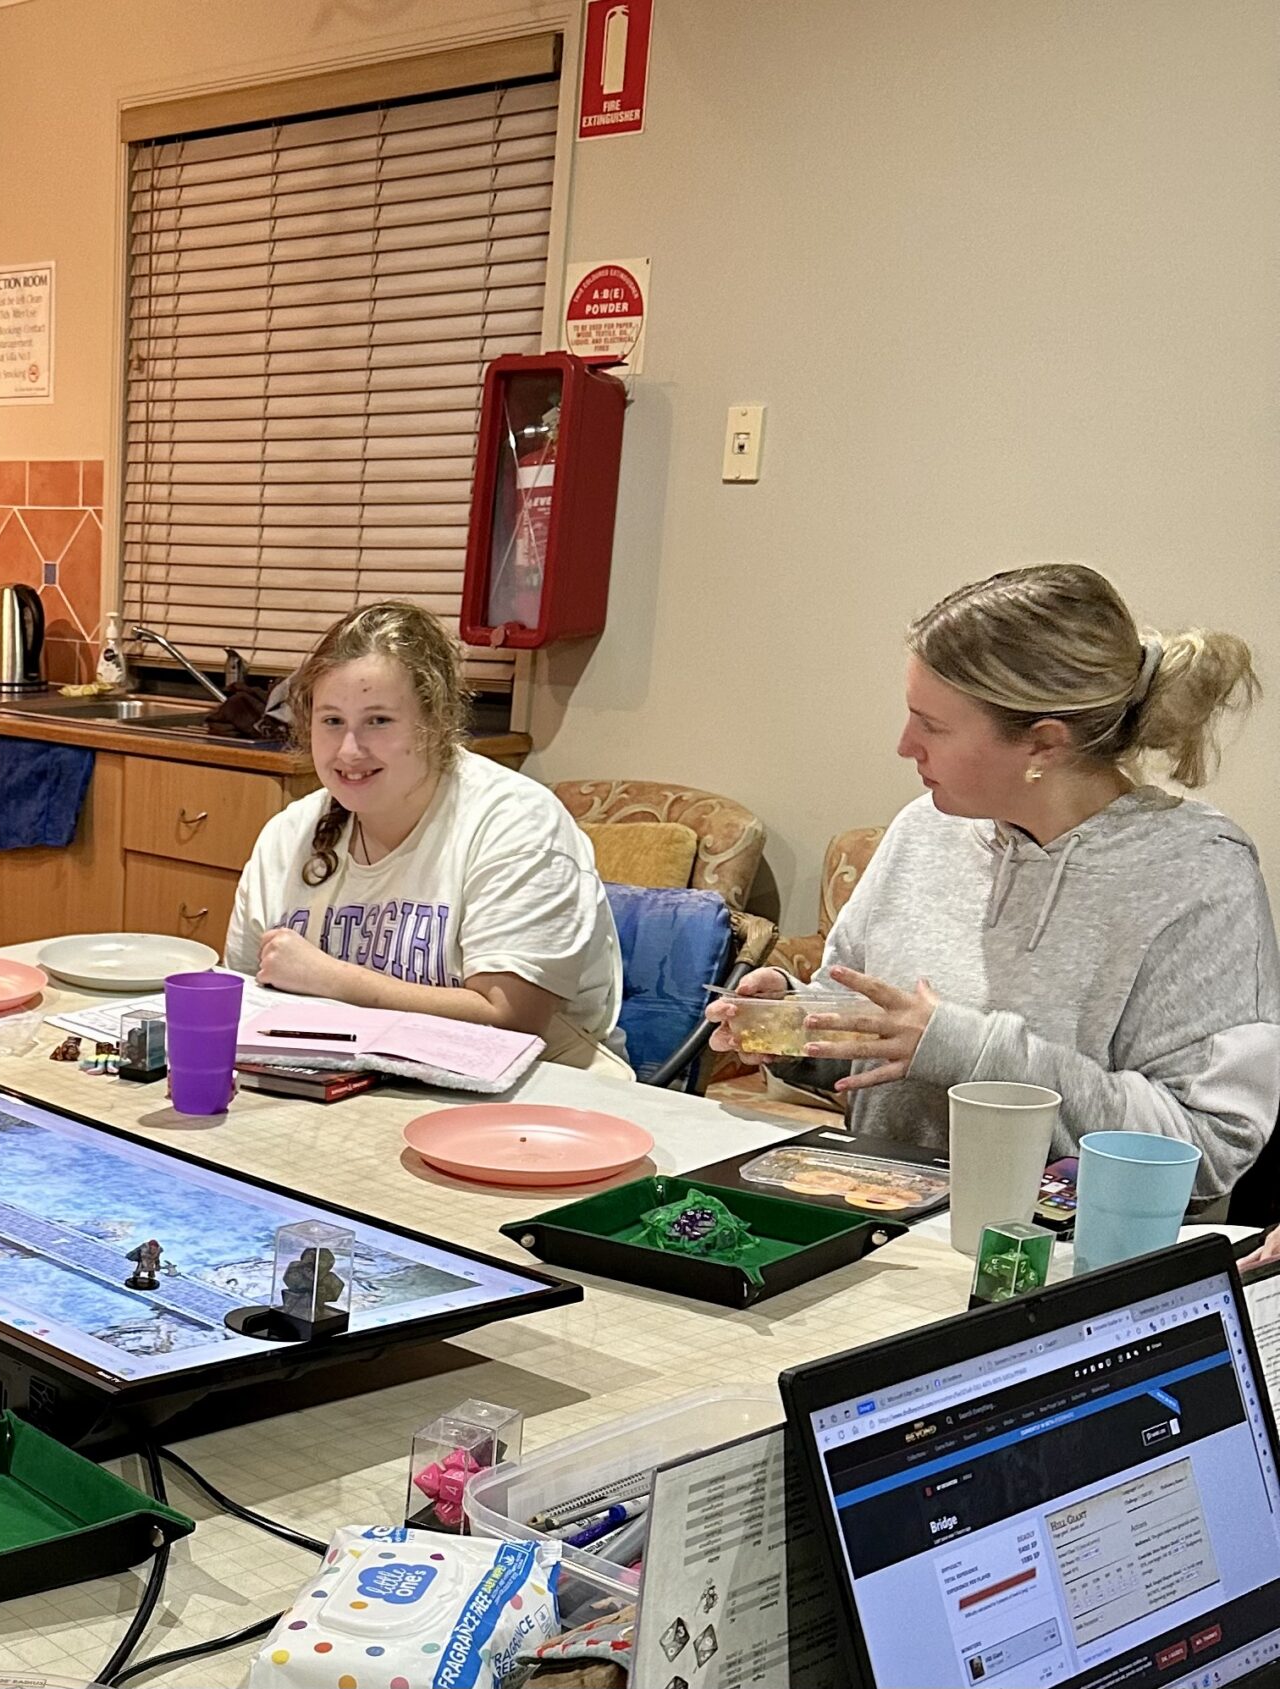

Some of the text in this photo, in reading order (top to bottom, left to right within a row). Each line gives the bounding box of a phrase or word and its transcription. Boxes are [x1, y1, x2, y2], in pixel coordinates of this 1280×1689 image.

[603, 99, 621, 112] FIRE
[582, 109, 641, 128] EXTINGUISHER
[23, 274, 48, 287] ROOM
[585, 302, 629, 315] POWDER
[905, 1425, 937, 1443] BEYOND
[445, 1485, 458, 1495] 4
[929, 1516, 958, 1534] Bridge
[1017, 1531, 1035, 1543] DEADLY
[365, 1567, 405, 1596] little
[396, 1569, 427, 1597] one's
[438, 1612, 481, 1689] FRAGRANCE
[472, 1592, 493, 1619] FREE
